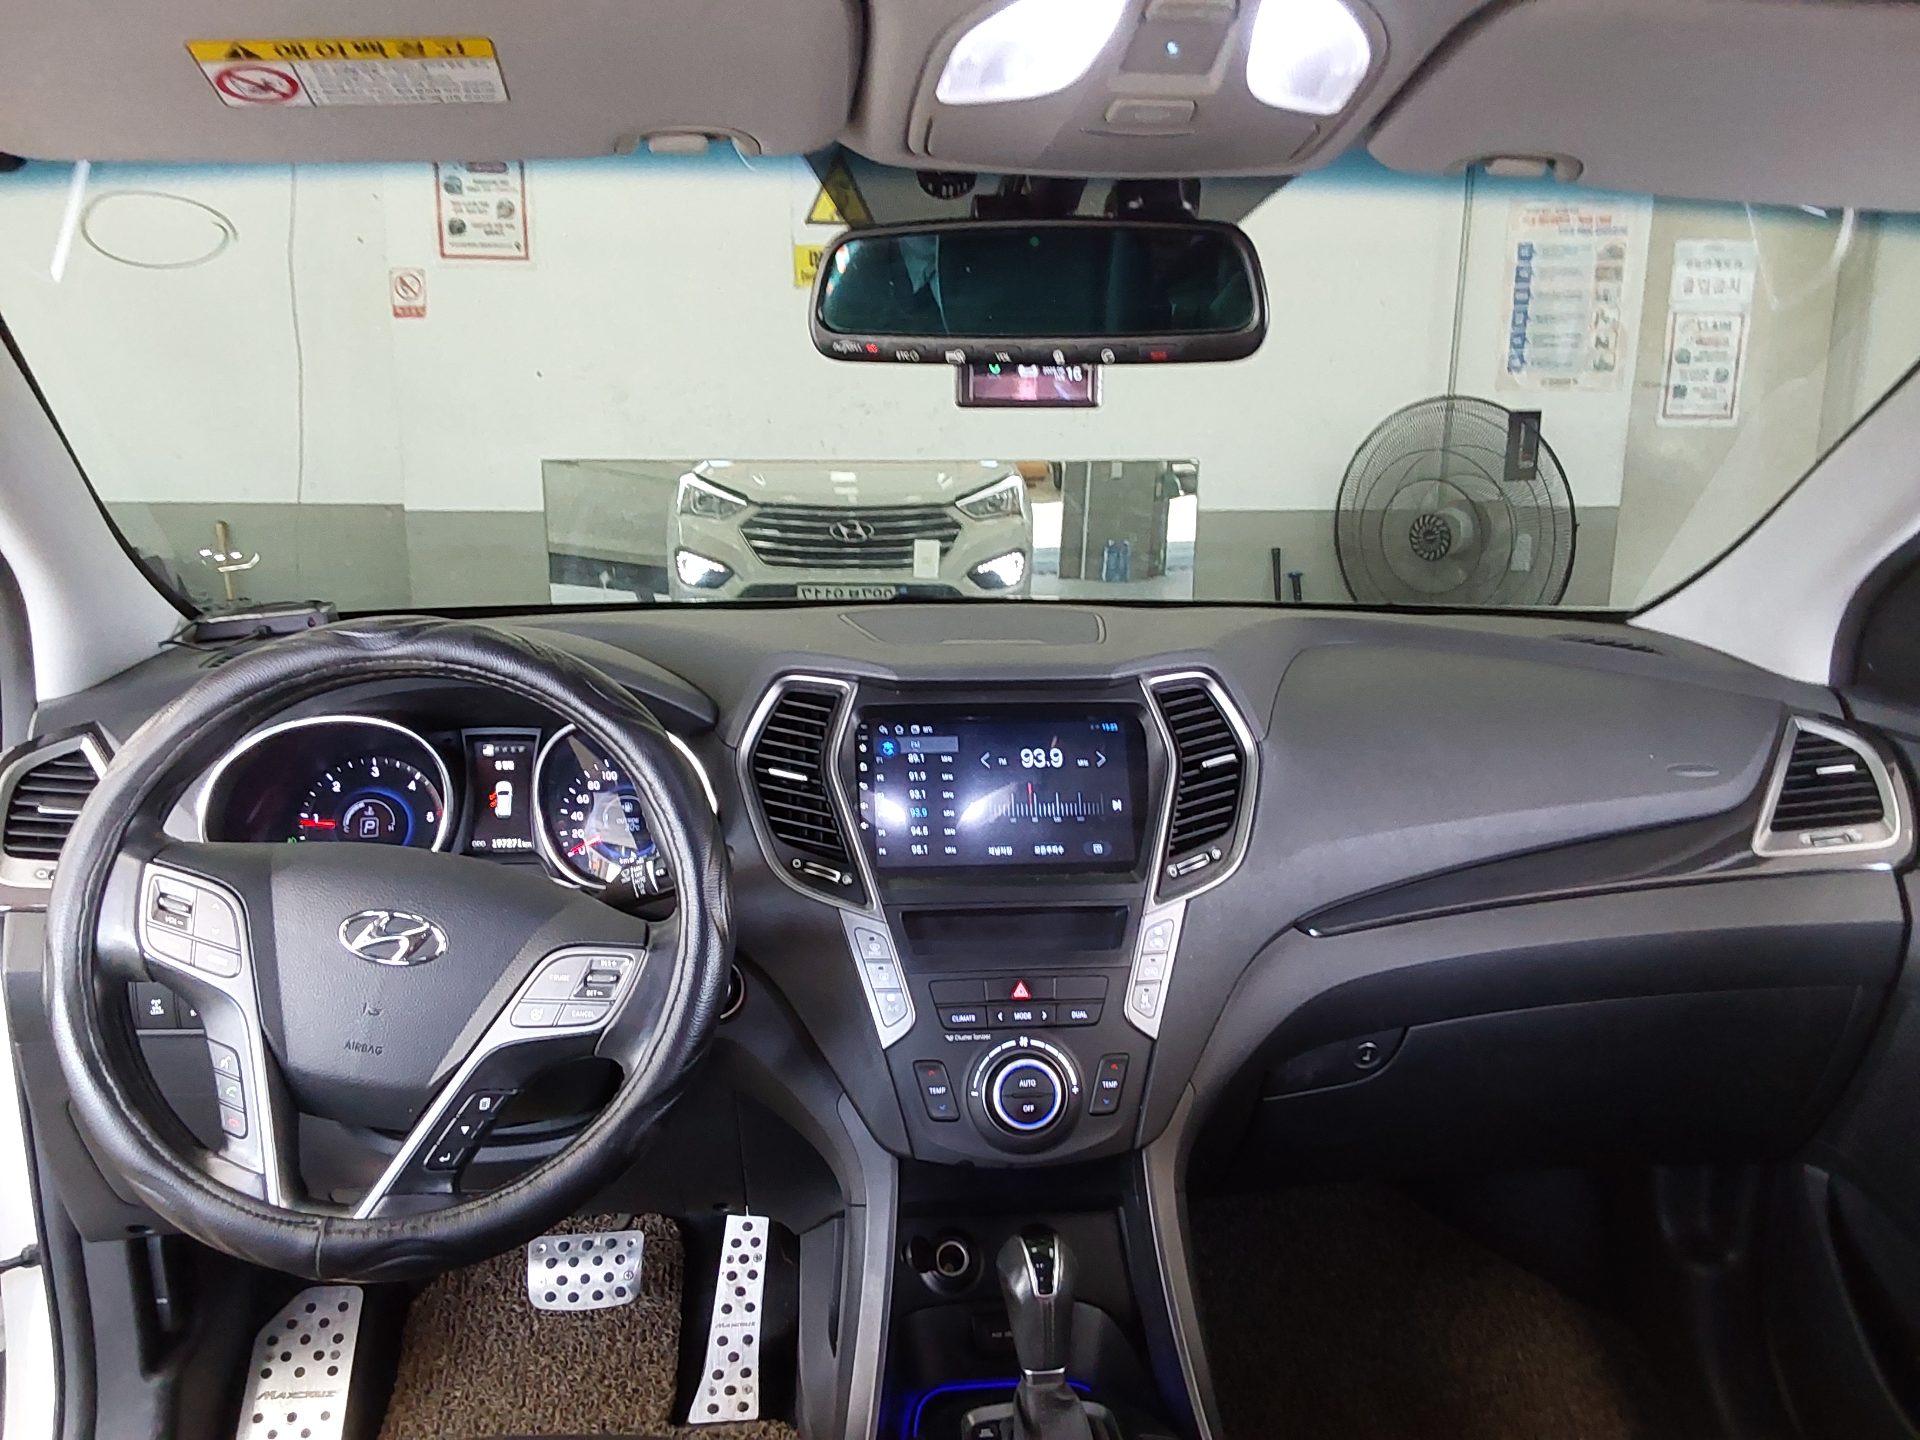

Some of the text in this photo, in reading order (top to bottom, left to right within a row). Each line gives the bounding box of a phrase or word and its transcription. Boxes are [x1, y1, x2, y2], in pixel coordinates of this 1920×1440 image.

[1020, 747, 1063, 769] 93.9
[370, 766, 380, 778] 3
[601, 770, 618, 781] 100
[331, 780, 341, 793] 2
[407, 780, 417, 791] 4
[587, 780, 600, 791] 80
[576, 794, 589, 804] 60
[570, 810, 584, 822] 40
[363, 821, 376, 834] P
[571, 828, 585, 839] 20
[344, 1039, 383, 1056] AIRBAG
[1019, 1079, 1037, 1088] AUTO
[1102, 1080, 1119, 1089] TEMP
[928, 1086, 946, 1096] TEMP
[1022, 1104, 1035, 1113] OFF
